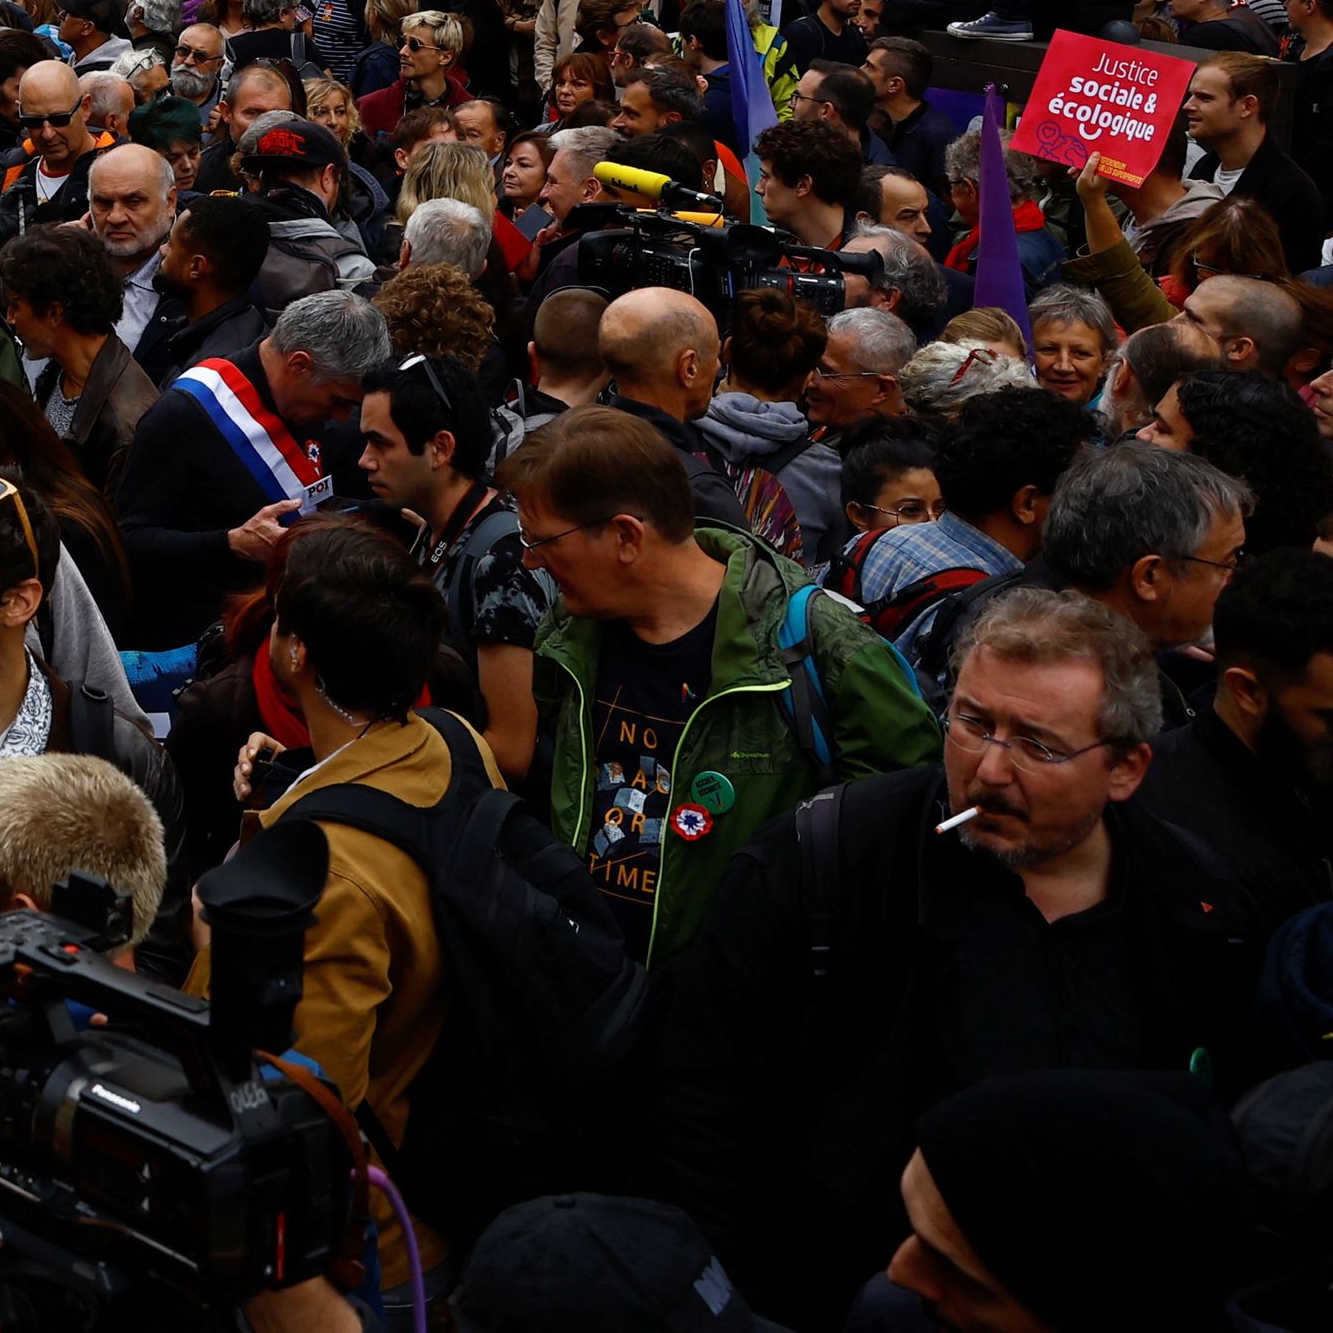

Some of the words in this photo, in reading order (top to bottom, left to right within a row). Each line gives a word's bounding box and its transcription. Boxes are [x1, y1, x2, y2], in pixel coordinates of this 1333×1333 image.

[1092, 52, 1159, 87] Justice
[1068, 76, 1143, 111] sociale
[1143, 92, 1159, 115] &
[1048, 92, 1155, 142] écologique
[430, 540, 448, 564] EOS
[619, 720, 658, 749] NO
[588, 853, 657, 894] TIME
